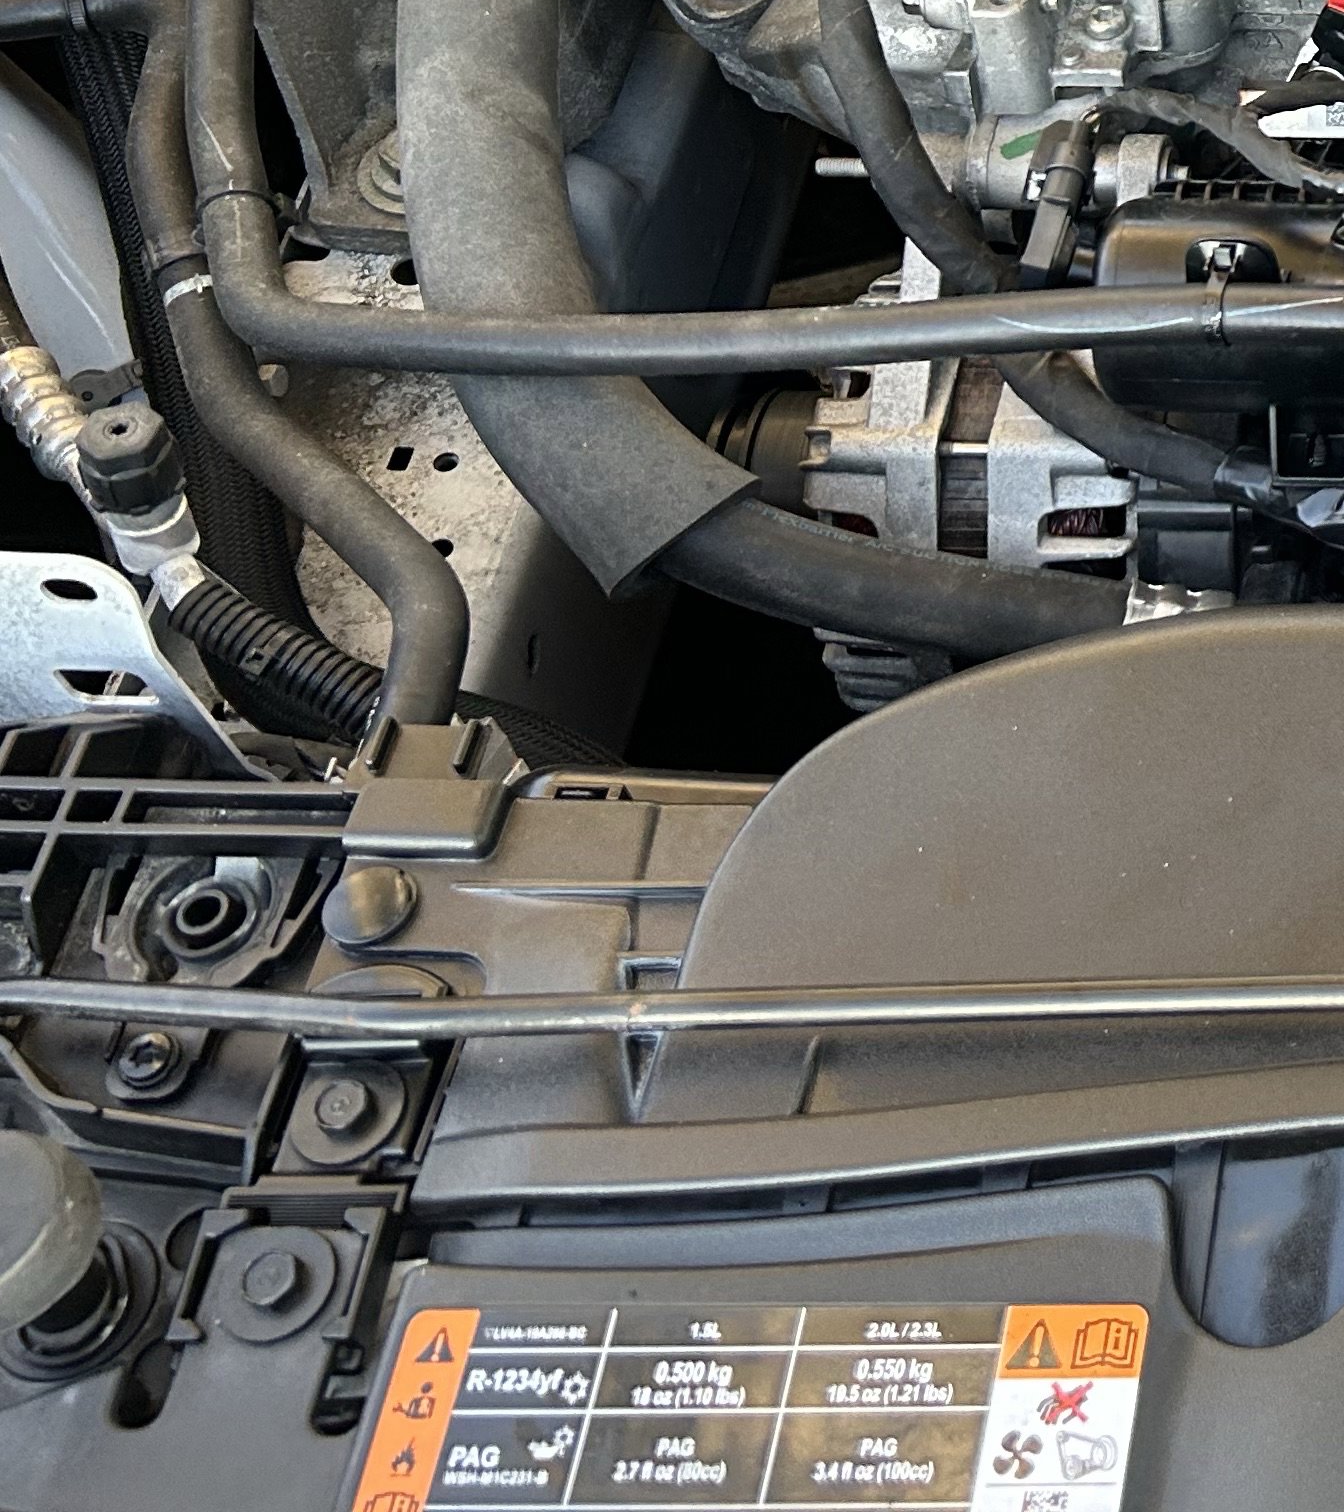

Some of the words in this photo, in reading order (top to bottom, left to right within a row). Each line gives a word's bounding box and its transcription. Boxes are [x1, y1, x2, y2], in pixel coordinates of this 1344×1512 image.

[866, 1322, 900, 1338] 2.0L
[909, 1322, 942, 1338] 2.3L
[466, 1368, 565, 1395] R-1234yf
[653, 1360, 705, 1383] 0.500
[707, 1362, 734, 1385] kg
[857, 1359, 906, 1381] 0.550
[908, 1359, 934, 1382] kg
[653, 1390, 675, 1406] oz
[862, 1388, 882, 1403] oz
[883, 1383, 921, 1405] (1.21
[922, 1383, 954, 1405] lbs)
[447, 1444, 501, 1468] PAG
[655, 1436, 696, 1458] PAG
[859, 1438, 898, 1457] PAG
[611, 1461, 639, 1483] 2.7
[654, 1464, 676, 1482] oz
[813, 1462, 839, 1481] 3.4
[853, 1464, 875, 1481] oz
[876, 1461, 935, 1483] (100cc)
